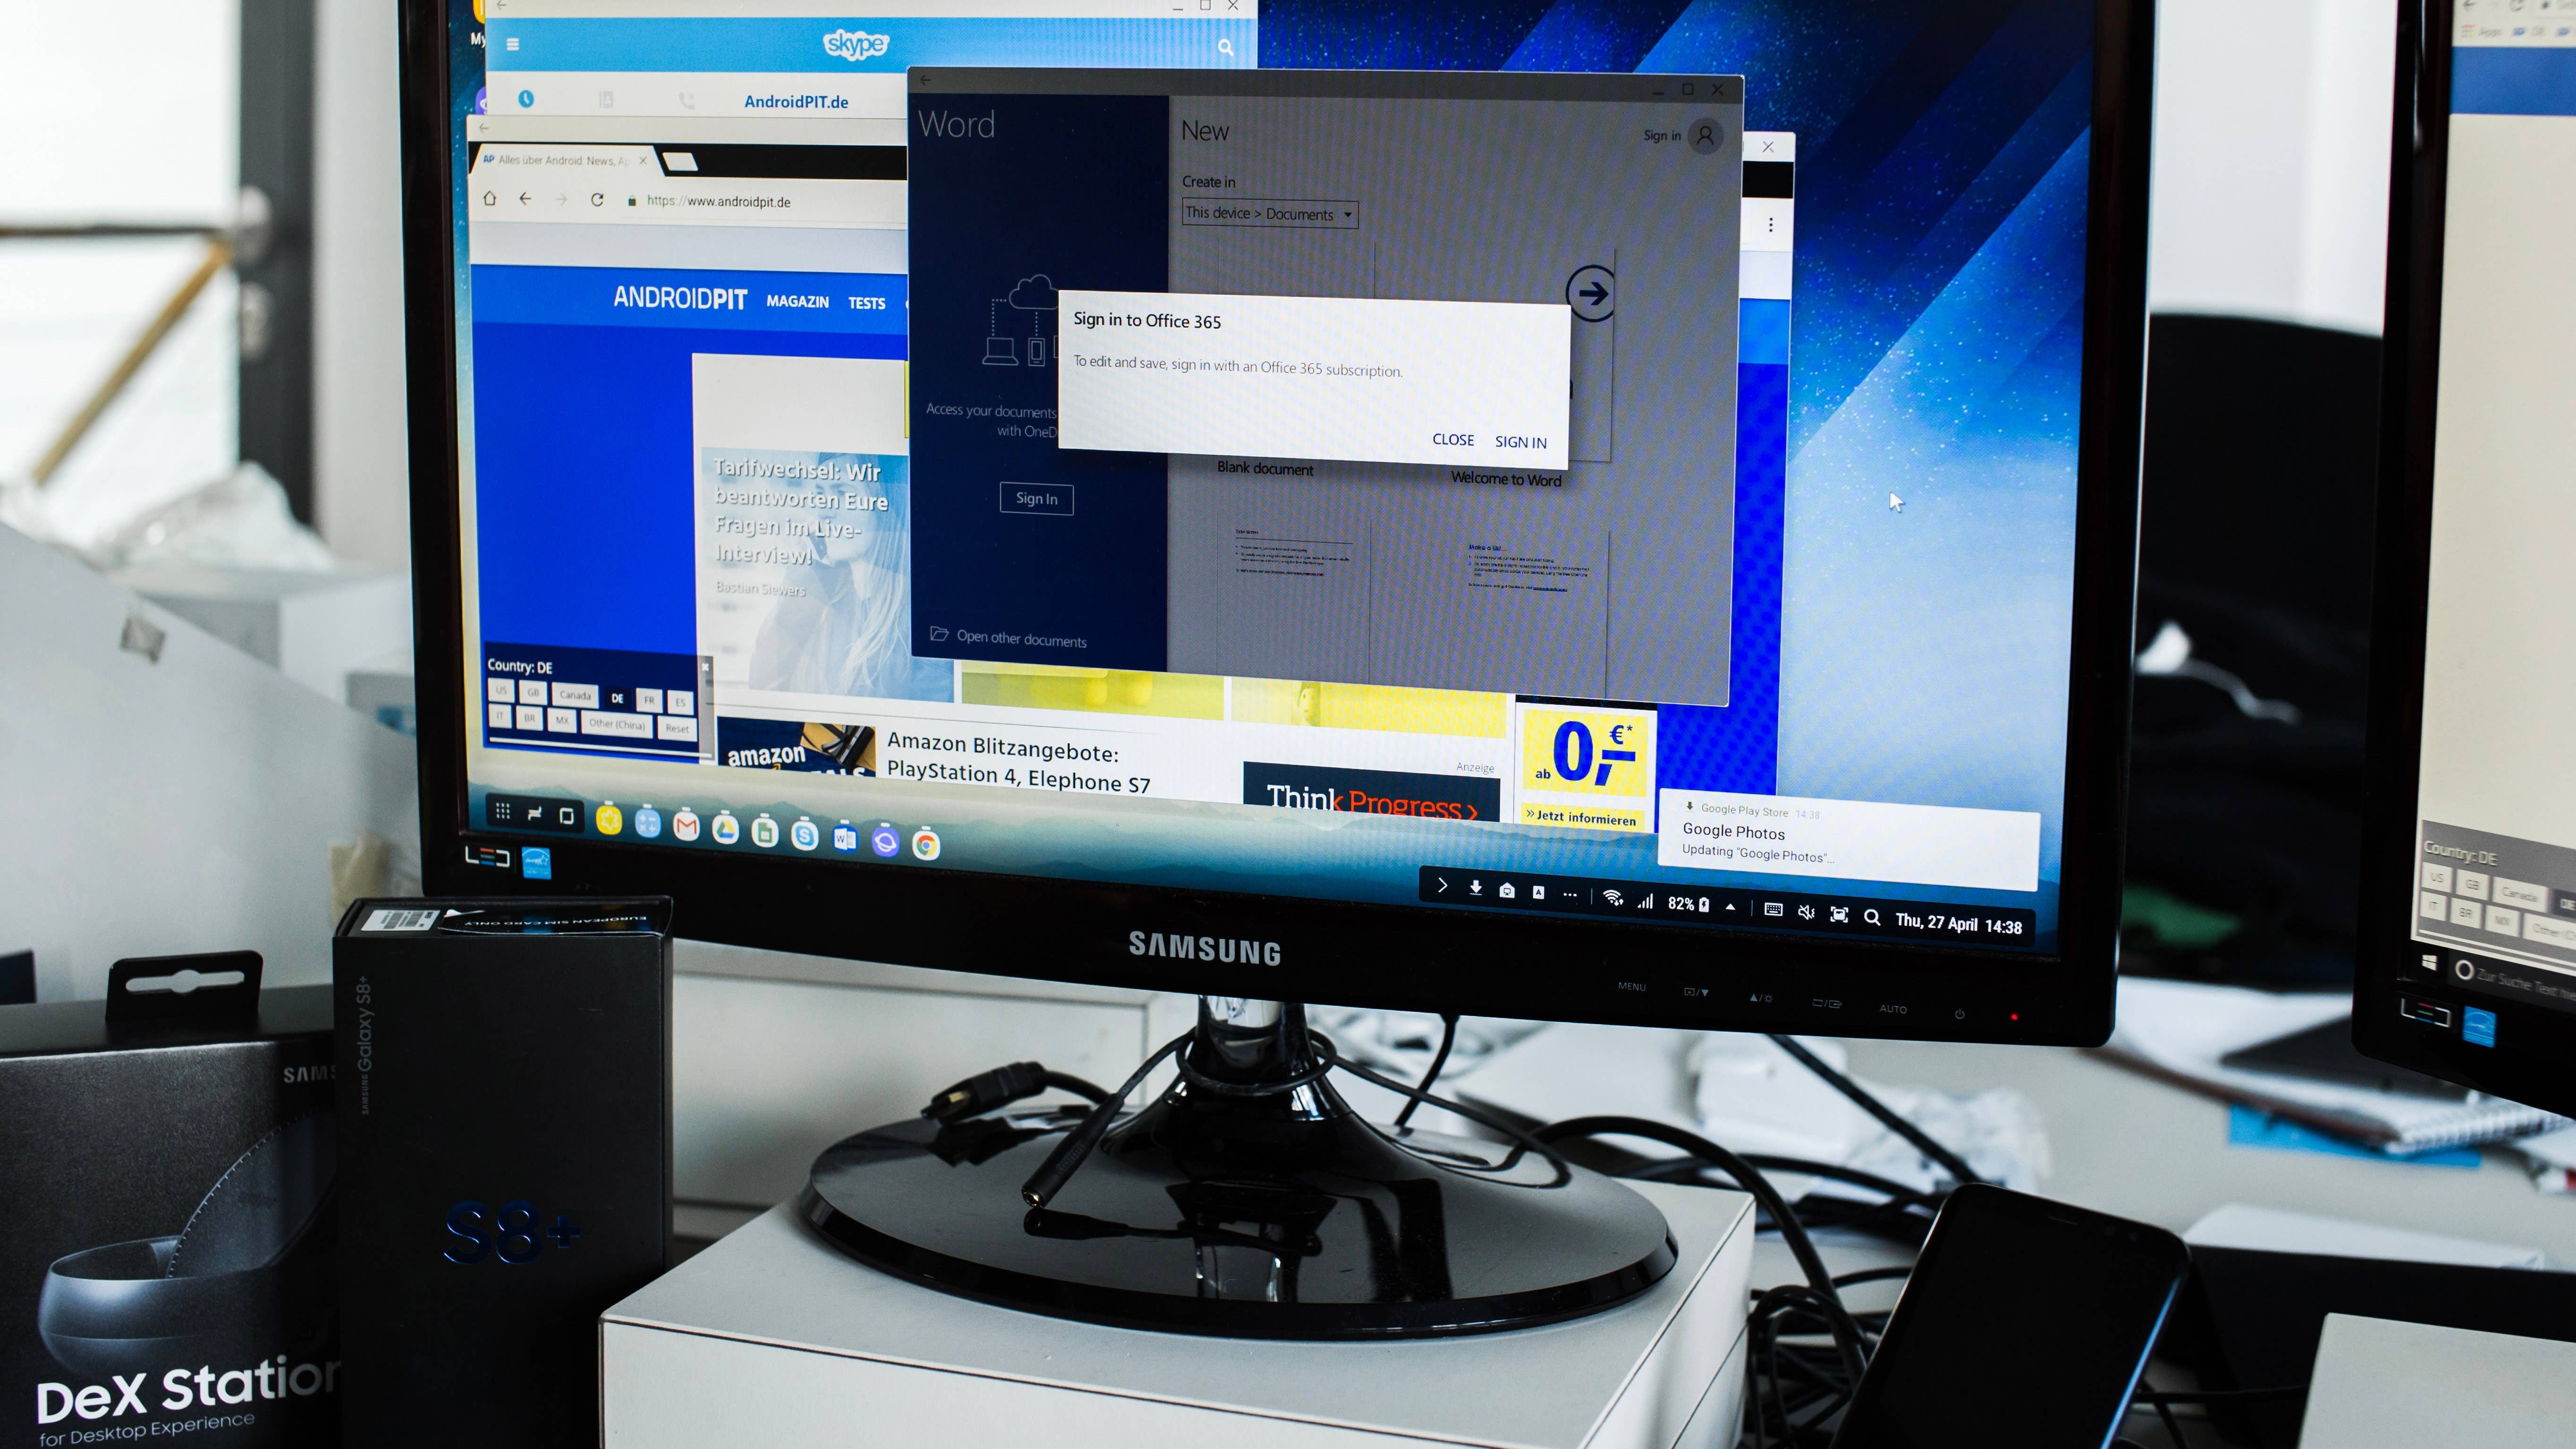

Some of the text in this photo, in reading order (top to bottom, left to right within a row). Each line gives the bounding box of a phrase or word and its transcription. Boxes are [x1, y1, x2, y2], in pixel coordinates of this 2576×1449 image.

[827, 31, 884, 58] skype
[745, 94, 848, 109] AndroidPIT.de
[919, 109, 995, 138] Word
[1183, 120, 1229, 142] New
[1644, 130, 1681, 144] Sign in
[499, 156, 519, 164] Alles
[523, 156, 542, 165] über
[587, 157, 615, 166] News,
[1183, 175, 1236, 189] Create in
[647, 194, 790, 209] https://www.androidpit.de
[1186, 205, 1210, 219] This
[1213, 206, 1250, 220] device
[1267, 207, 1333, 222] Documents
[614, 286, 747, 310] ANDROIDPIT
[767, 295, 829, 308] MAGAZIN
[849, 297, 886, 310] TESTS
[1074, 312, 1221, 329] Sign in to Office 365
[1074, 355, 1403, 380] To edit and save, sign in with an Office 365 subscription.
[926, 403, 1057, 419] Access your documents
[998, 425, 1021, 437] with
[1433, 433, 1474, 446] CLOSE
[1496, 436, 1547, 449] SIGN IN
[713, 458, 881, 482] Tarifwechsel: Wir
[1218, 461, 1314, 476] Blank document
[1451, 471, 1562, 487] Welcome to Word
[715, 486, 889, 511] beantworten Eure
[1017, 492, 1058, 507] Sign In
[715, 516, 862, 538] Fragen im Live-
[716, 544, 812, 565] Interview!
[716, 581, 758, 594] Bastian
[958, 630, 1087, 648] Open other documents
[488, 659, 552, 676] Country: DE
[496, 686, 507, 695] US
[527, 688, 539, 697] GB
[560, 690, 591, 701] Canada
[612, 693, 624, 703] DE
[644, 696, 655, 705] FR
[676, 698, 686, 707] ES
[497, 712, 503, 721] IT
[524, 714, 535, 722] BR
[556, 716, 569, 725] MX
[590, 718, 645, 732] Other (China)
[666, 724, 689, 734] Reset
[888, 732, 1119, 763] Amazon Blitzangebote:
[728, 746, 806, 767] amazon
[1457, 762, 1494, 773] Anzeige
[1536, 769, 1551, 780] ab
[888, 760, 997, 784] PlayStation
[1004, 769, 1022, 787] 4,
[1029, 770, 1122, 793] Elephone
[1129, 777, 1151, 795] S7
[1538, 810, 1636, 827] Jetzt informieren
[1702, 804, 1820, 820] Google Play Store 14:38
[1683, 822, 1785, 840] Google Photos
[1682, 844, 1733, 858] Updating
[1737, 847, 1779, 861] "Google
[2424, 840, 2498, 867] Country: DE
[1669, 897, 1695, 911] 82%
[1896, 913, 2022, 934] Thu, 27 April 14:38
[1129, 931, 1280, 966] SAMSUNG
[356, 975, 371, 1004] S8+
[1618, 982, 1646, 991] MENU
[1880, 1004, 1907, 1014] AUTO
[357, 1008, 375, 1072] Galaxy
[443, 1200, 581, 1265] S8+
[37, 1373, 147, 1424] DeX
[40, 1413, 255, 1447] for Desktop Experience
